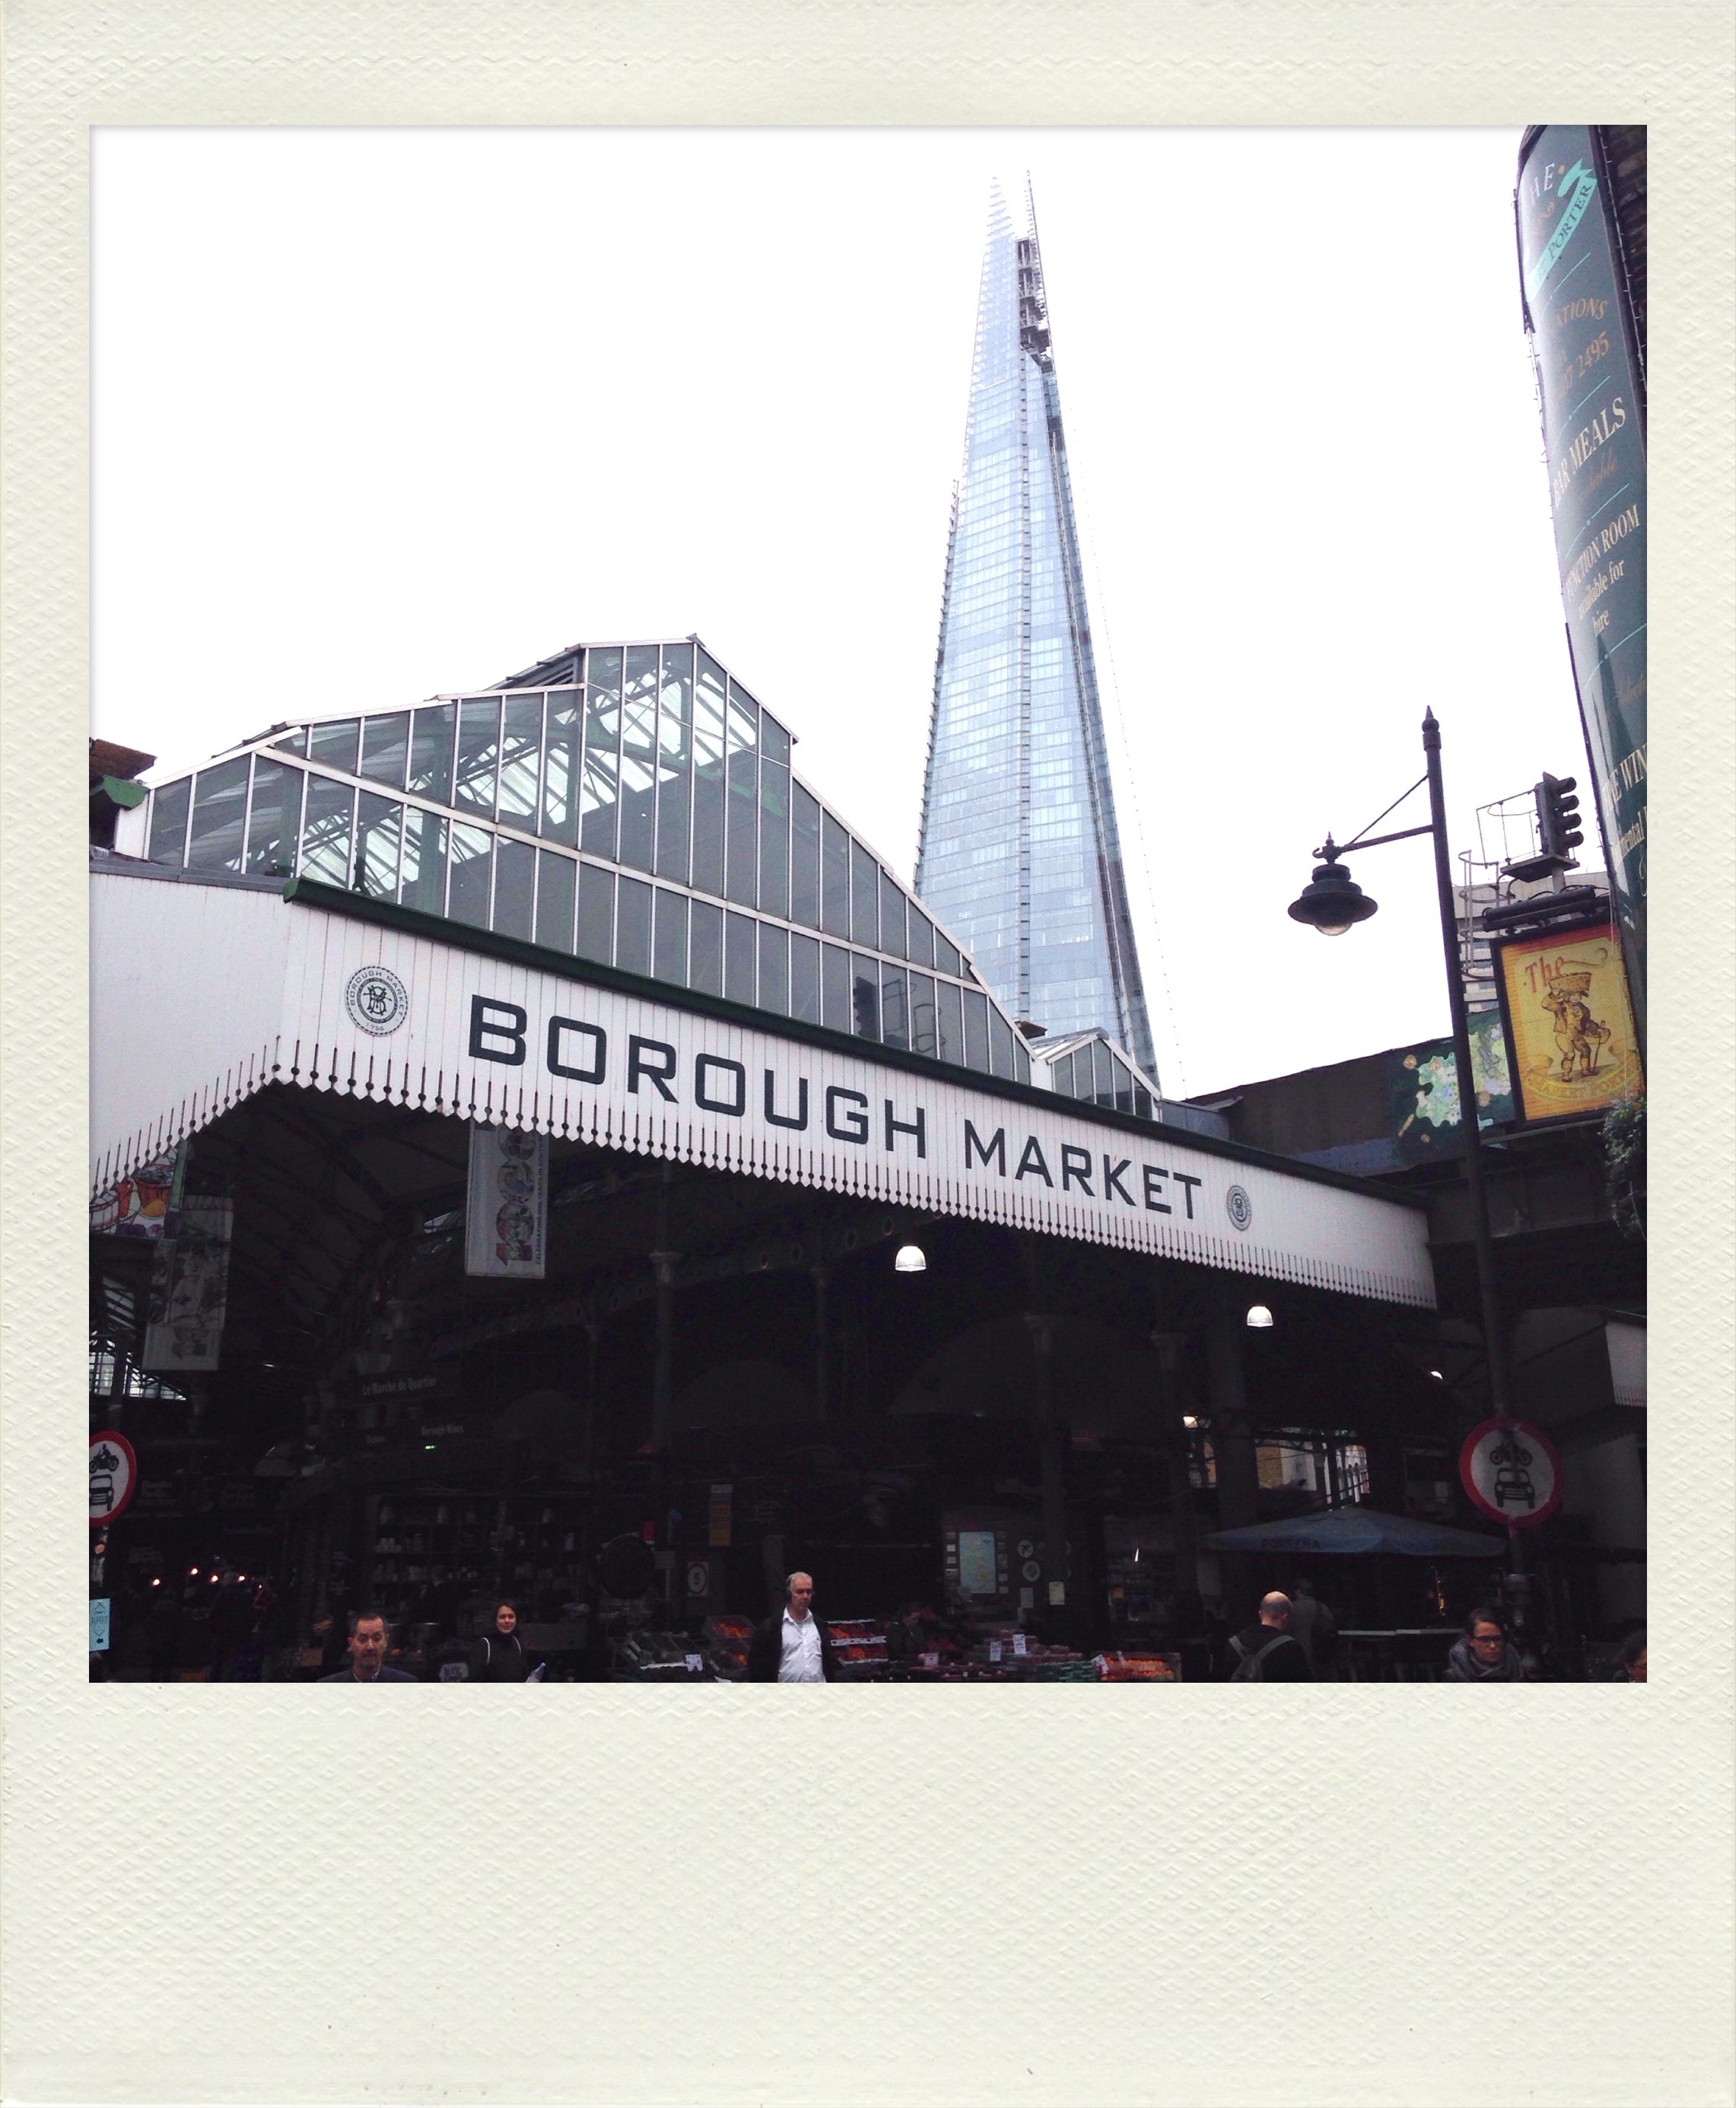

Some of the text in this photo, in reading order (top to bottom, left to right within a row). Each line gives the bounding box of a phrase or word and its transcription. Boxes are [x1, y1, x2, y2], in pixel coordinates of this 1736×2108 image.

[1548, 185, 1592, 262] PORTER
[1569, 396, 1626, 475] MEALS
[1601, 504, 1641, 553] ROOM
[1609, 559, 1625, 585] for
[349, 970, 383, 1006] BOROUGH
[386, 975, 405, 1016] MARKET
[469, 994, 1202, 1219] BOROUGH MARKET
[693, 1572, 700, 1585] 5
